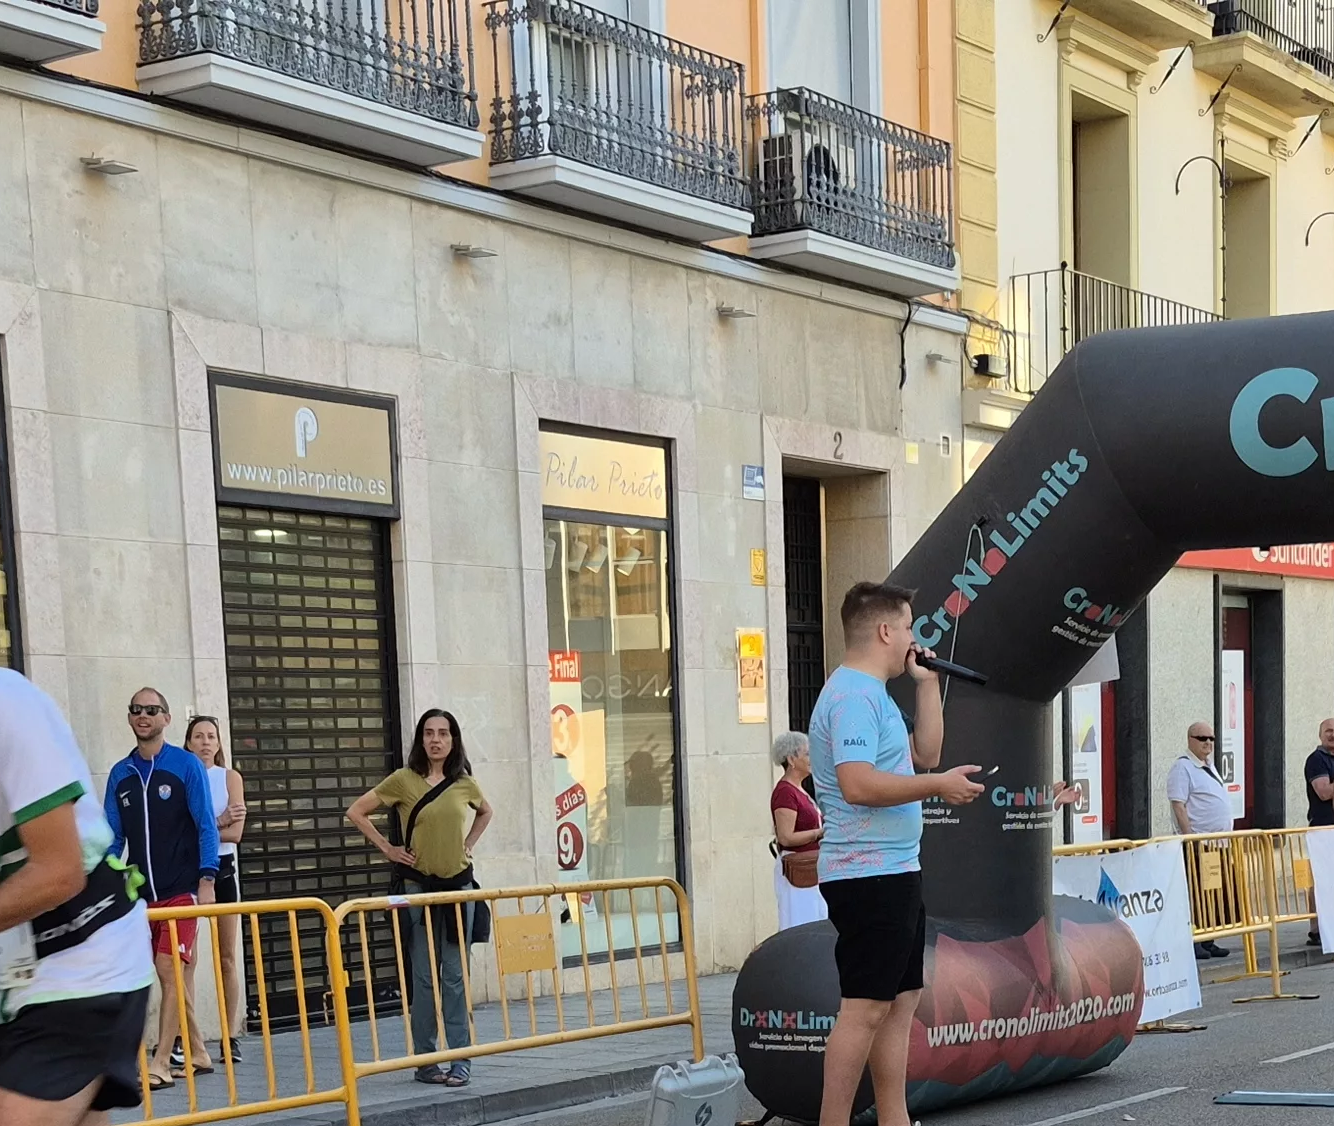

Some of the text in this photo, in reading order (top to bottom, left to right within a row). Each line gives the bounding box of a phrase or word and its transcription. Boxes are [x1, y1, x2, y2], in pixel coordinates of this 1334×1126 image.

[833, 431, 844, 460] 2
[227, 462, 387, 496] www.pilarprieto.es
[545, 452, 663, 500] Pilar Prieto
[555, 652, 579, 680] Final
[843, 736, 868, 747] RAÚL
[563, 788, 586, 813] días
[927, 989, 1136, 1049] www.cronolimits2020.com
